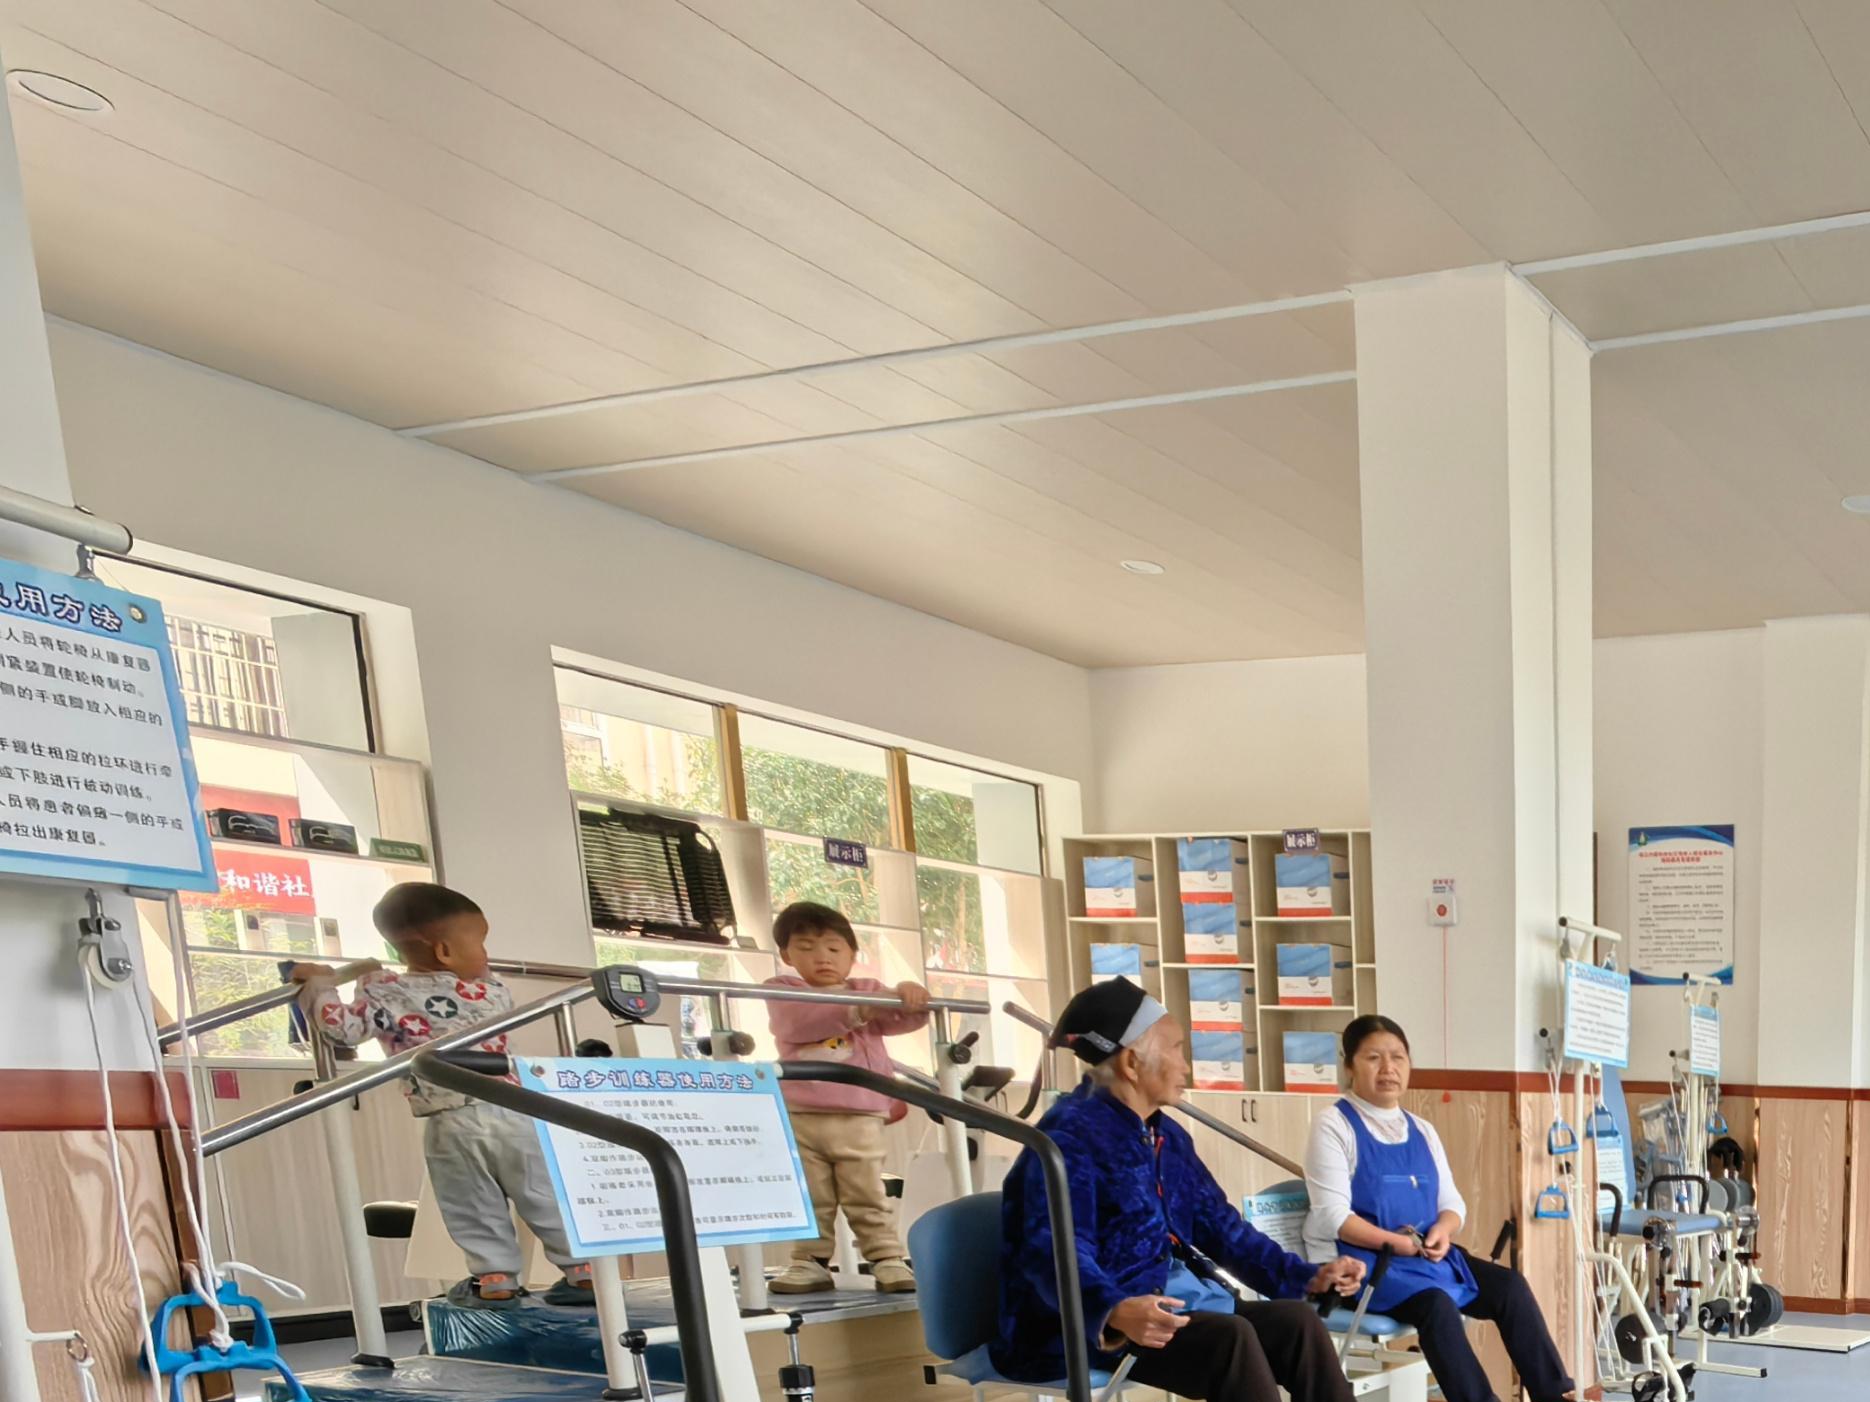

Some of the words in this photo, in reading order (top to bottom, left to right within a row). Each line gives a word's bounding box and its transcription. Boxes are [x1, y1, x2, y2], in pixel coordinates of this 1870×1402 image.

[0, 626, 151, 672] 人员将轮椅从康复器
[556, 1069, 754, 1090] 踏步训练器使用方法
